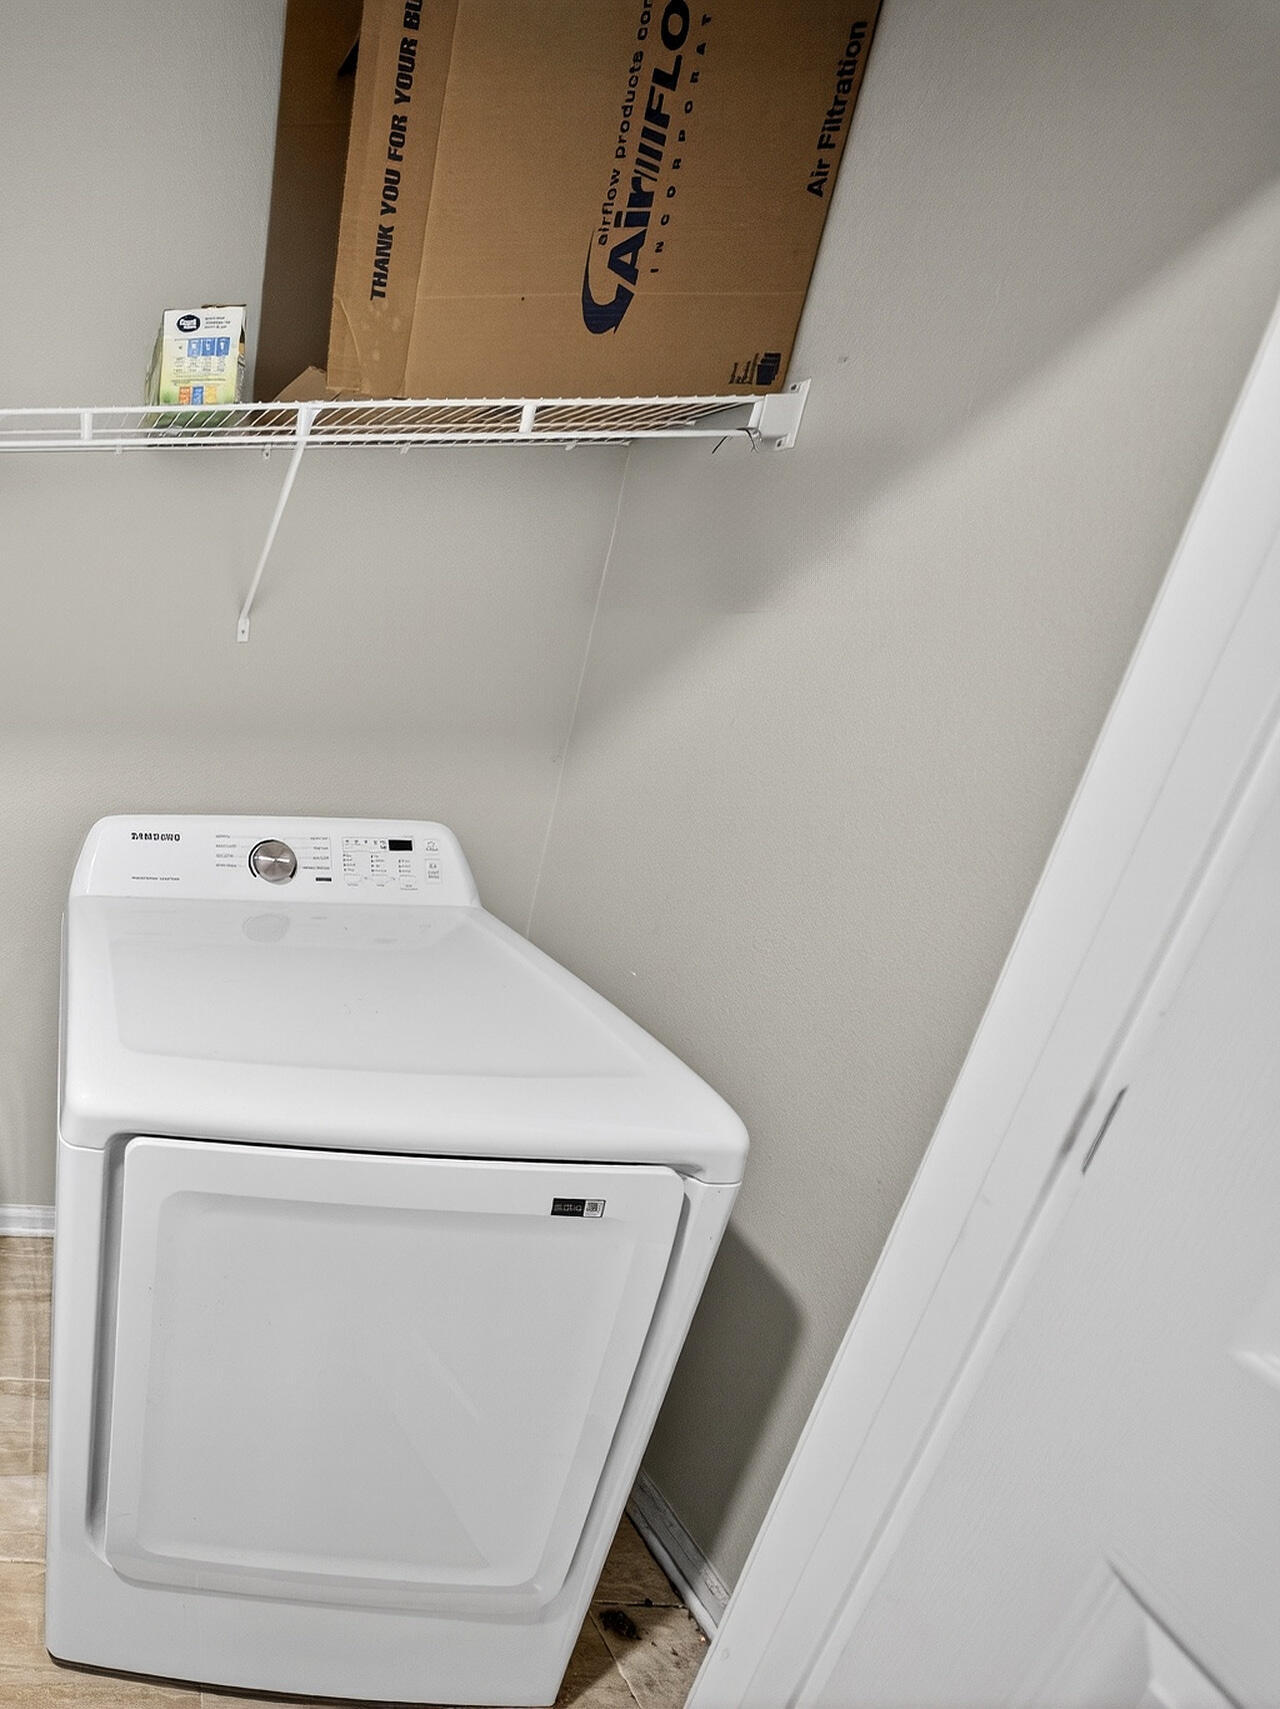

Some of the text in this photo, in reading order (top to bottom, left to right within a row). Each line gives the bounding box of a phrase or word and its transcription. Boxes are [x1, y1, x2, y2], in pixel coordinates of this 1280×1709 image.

[394, 36, 418, 104] YOUR
[387, 114, 408, 162] FOR
[806, 21, 868, 198] Air Filtration
[598, 168, 621, 246] airflow
[615, 51, 643, 159] products
[380, 168, 401, 216] YOU
[370, 224, 395, 300] THANK
